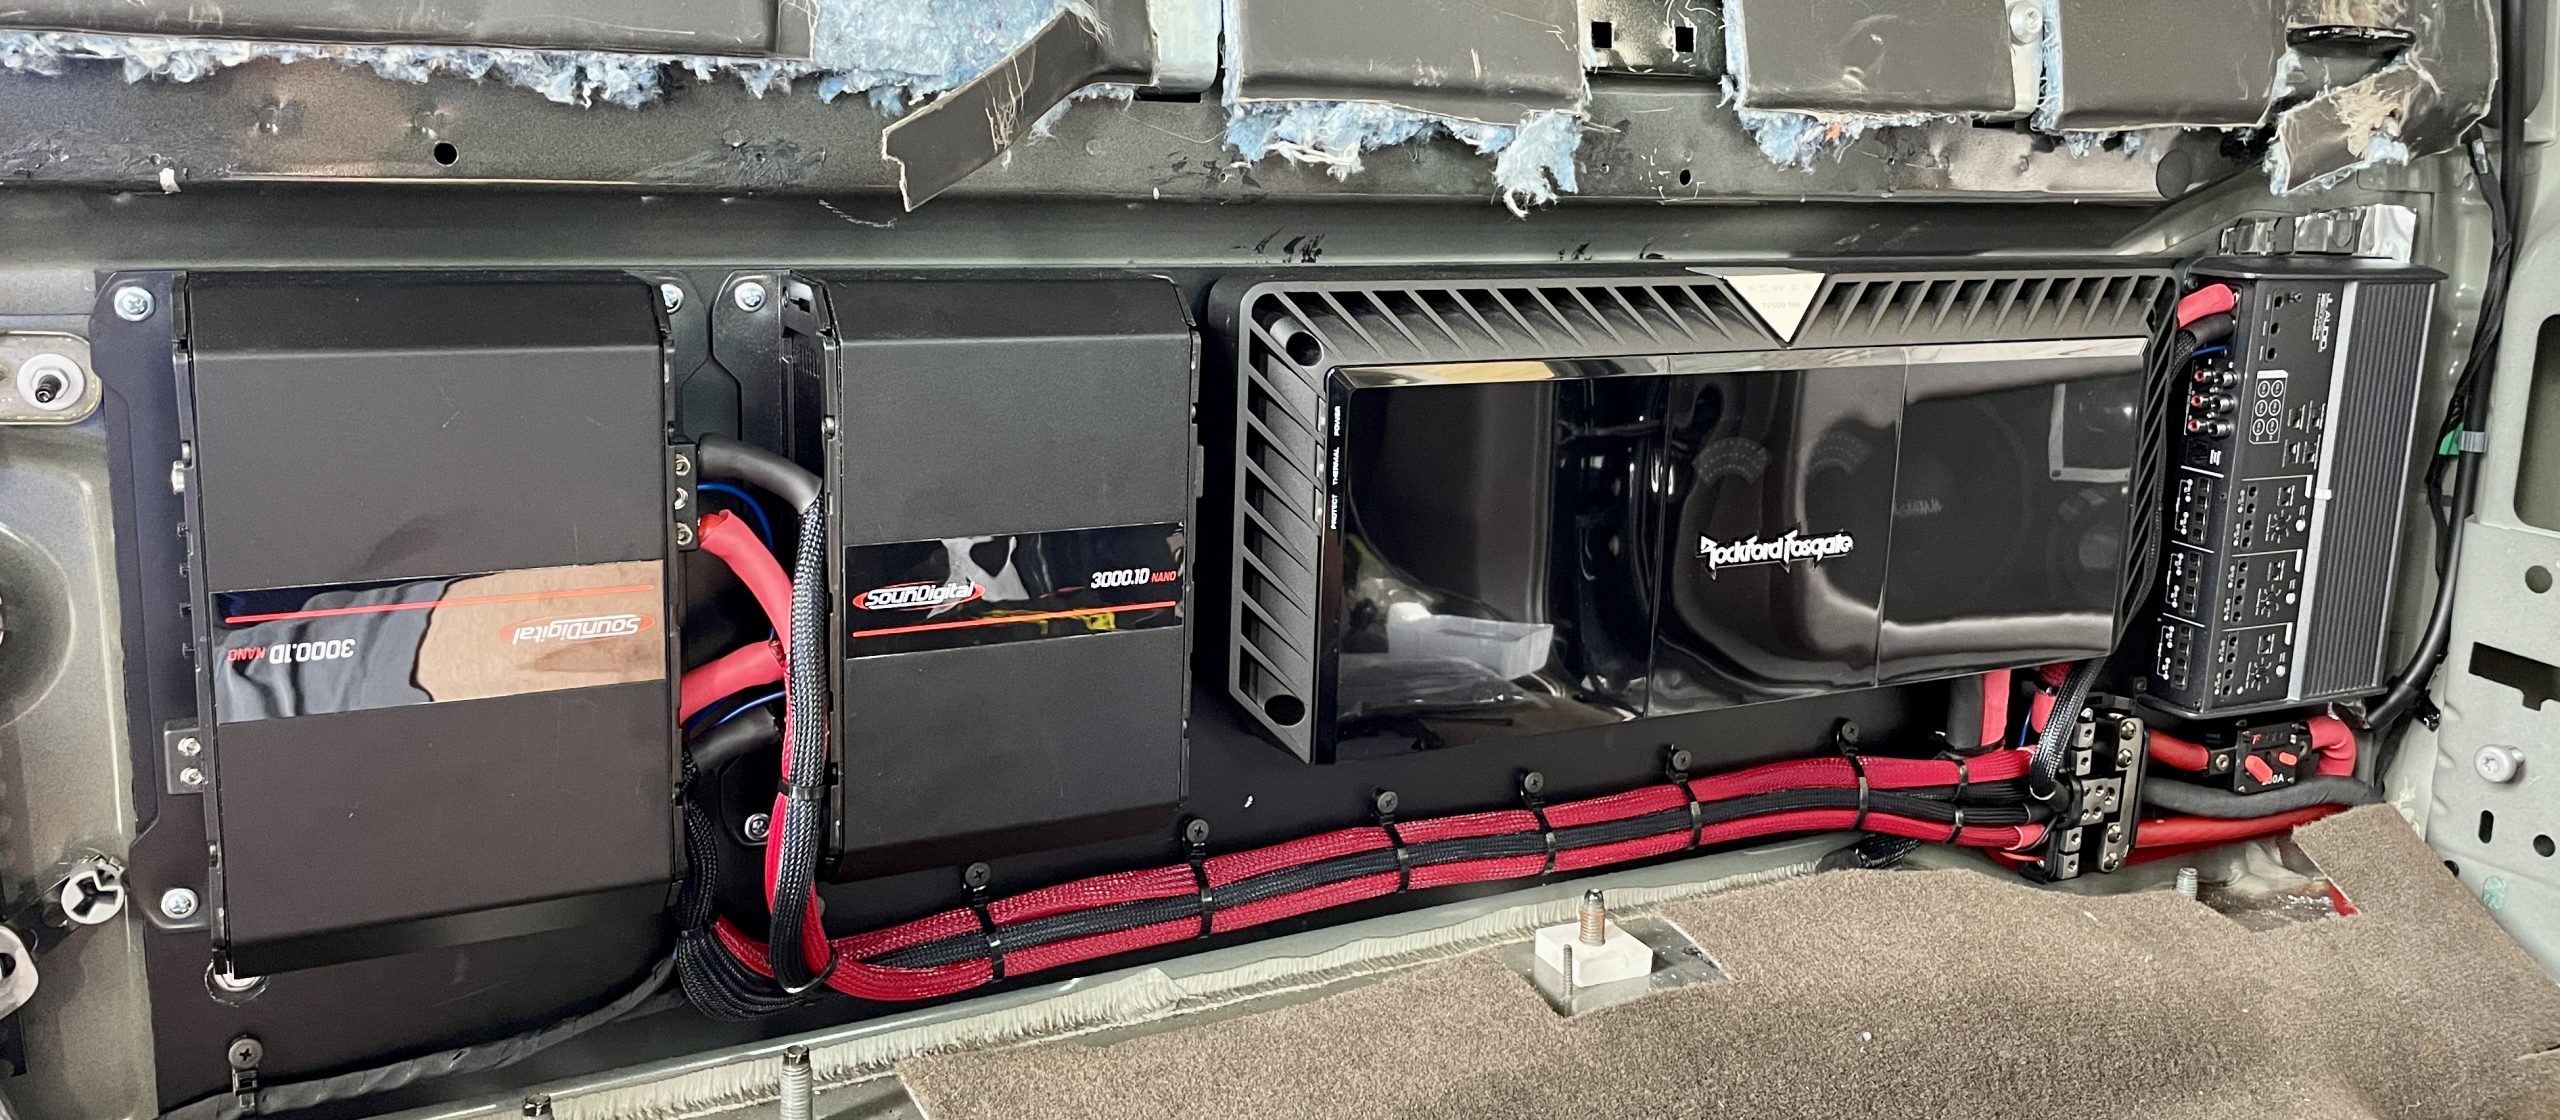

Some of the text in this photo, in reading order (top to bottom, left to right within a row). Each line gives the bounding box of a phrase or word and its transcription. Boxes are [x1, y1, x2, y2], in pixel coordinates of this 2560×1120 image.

[1332, 446, 1340, 486] THERMAL
[1330, 494, 1339, 530] PROTECT
[1700, 529, 1853, 571] Rockford Fosgate
[1090, 567, 1177, 590] 3000.1D NANO
[864, 581, 976, 610] SounDigital
[512, 613, 642, 646] SounDigital
[227, 638, 356, 665] 3000.1D NANO
[2261, 773, 2285, 786] 0A
